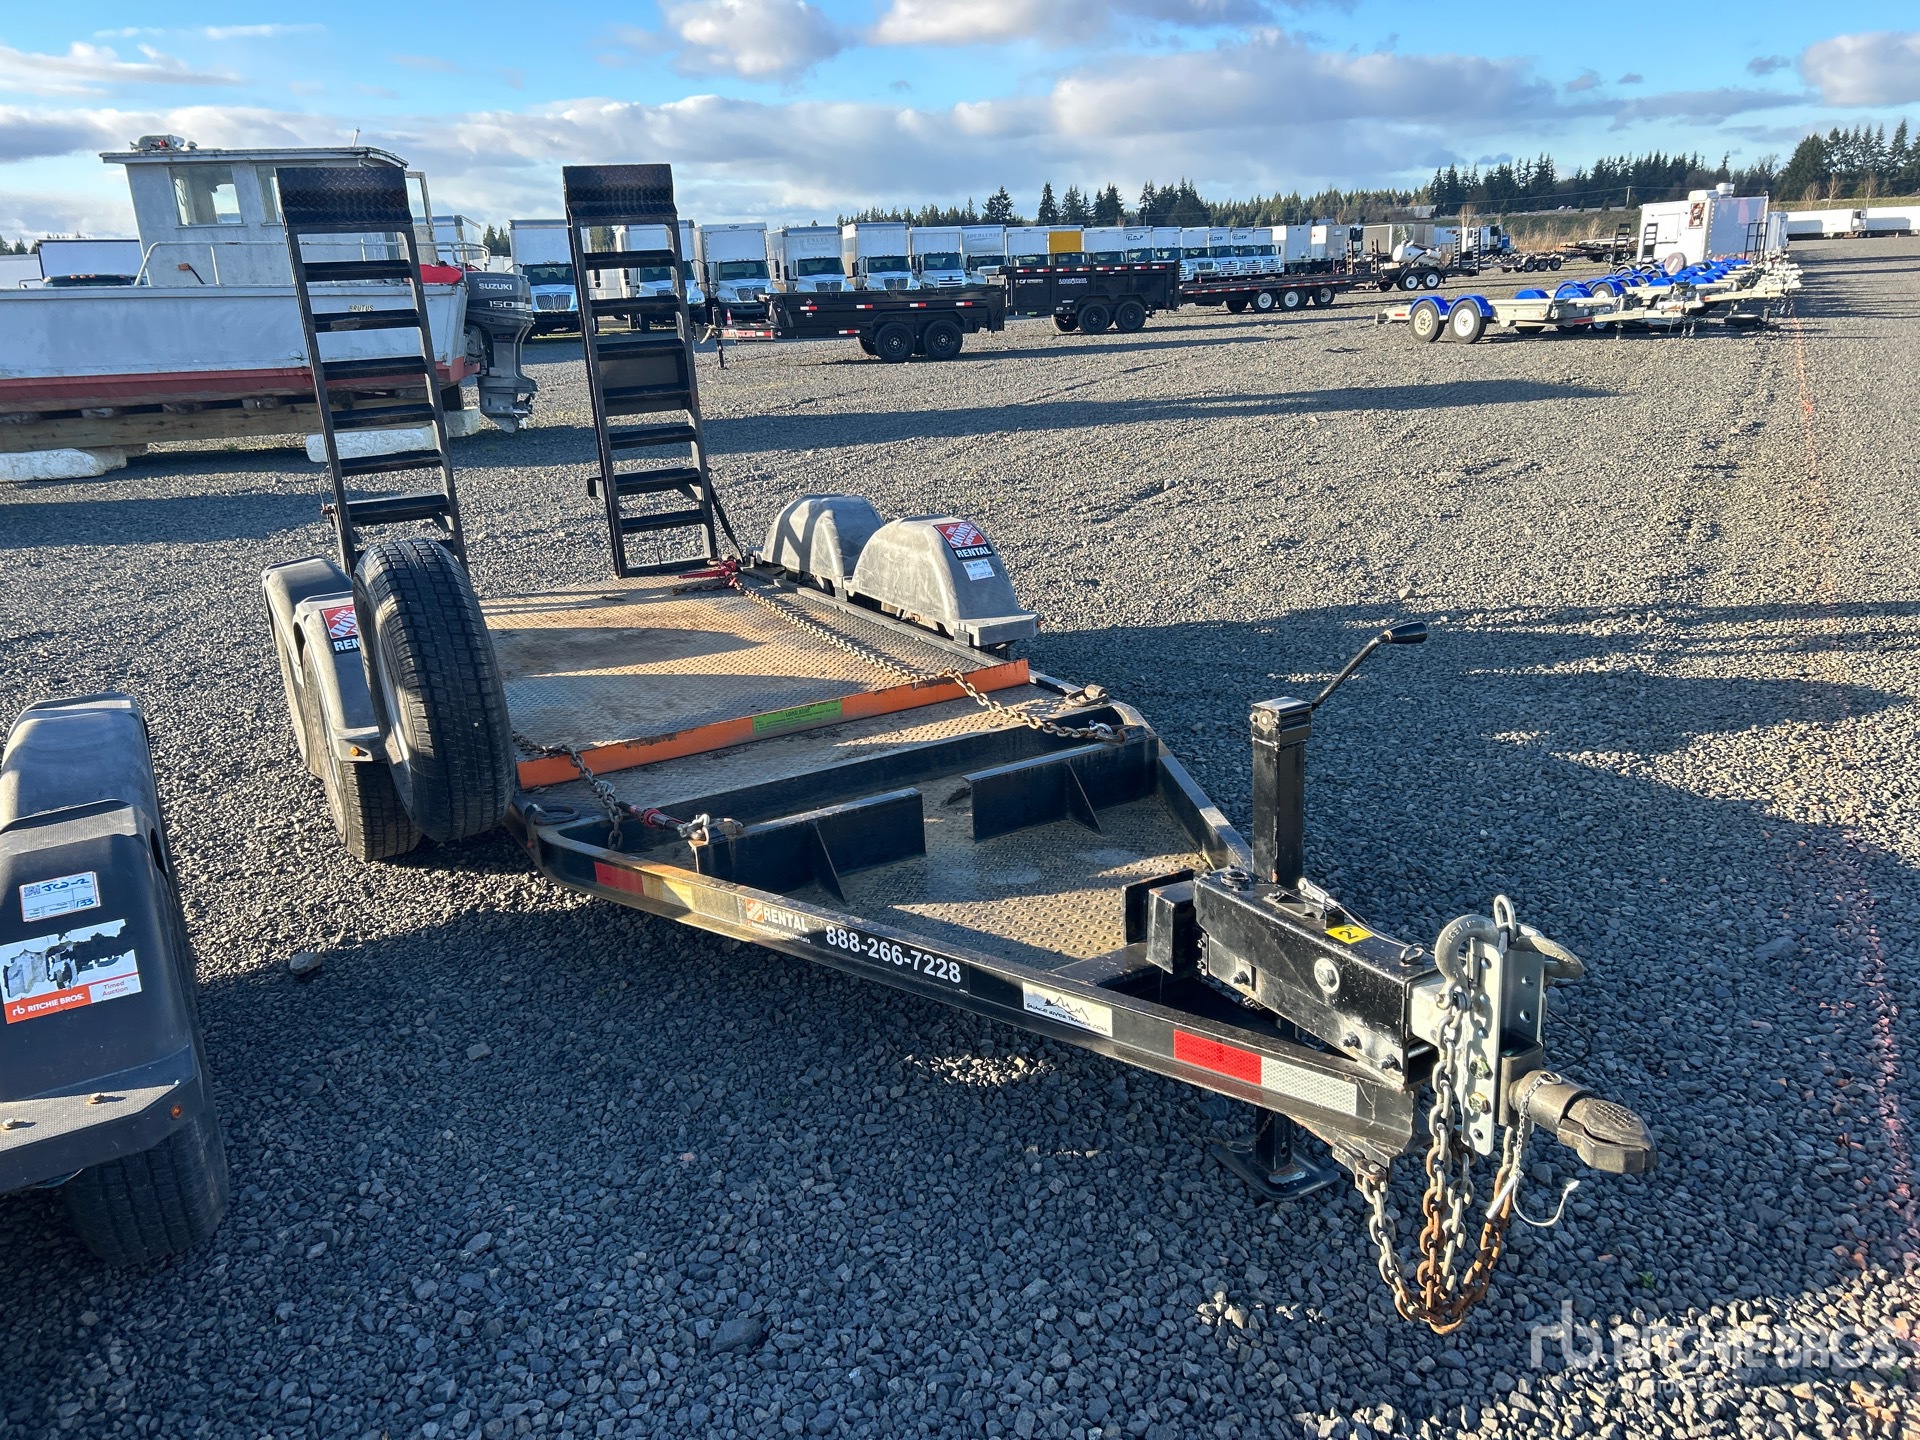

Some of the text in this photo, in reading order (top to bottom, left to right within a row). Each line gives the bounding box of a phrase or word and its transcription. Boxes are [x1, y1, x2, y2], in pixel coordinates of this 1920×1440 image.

[478, 282, 513, 290] SUZUKI
[349, 304, 374, 312] BRUTUS
[489, 300, 514, 308] 150
[955, 546, 992, 558] RENTAL
[330, 609, 350, 621] THE
[333, 638, 361, 652] REN
[76, 898, 95, 908] 133
[763, 906, 809, 933] RENTAL
[825, 925, 962, 984] 888-266-7228
[102, 985, 129, 997] Auction
[103, 980, 125, 990] Timed
[27, 998, 60, 1013] RITCHIE
